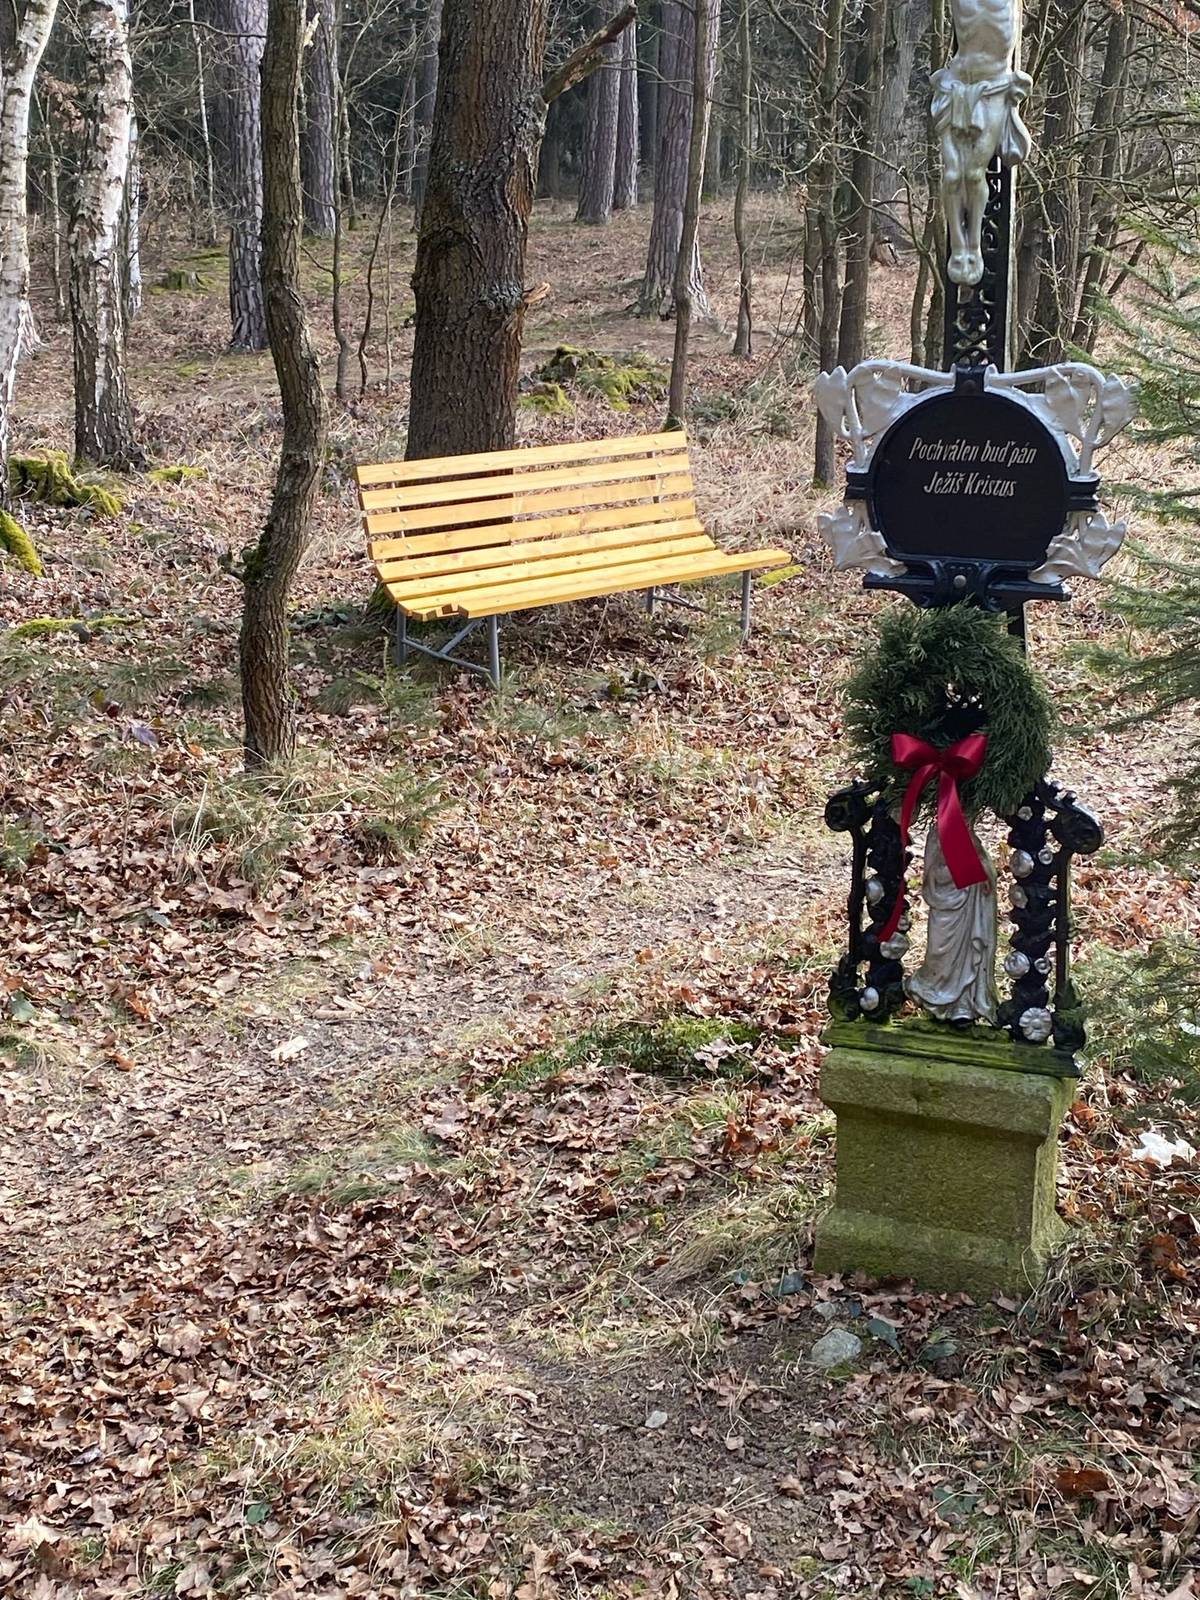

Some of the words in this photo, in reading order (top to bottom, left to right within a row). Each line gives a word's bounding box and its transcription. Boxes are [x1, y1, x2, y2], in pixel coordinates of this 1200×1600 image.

[908, 437, 979, 461] Pochválen
[1007, 442, 1037, 468] pán
[923, 471, 964, 494] Ježíš
[964, 472, 1017, 497] Kristus
